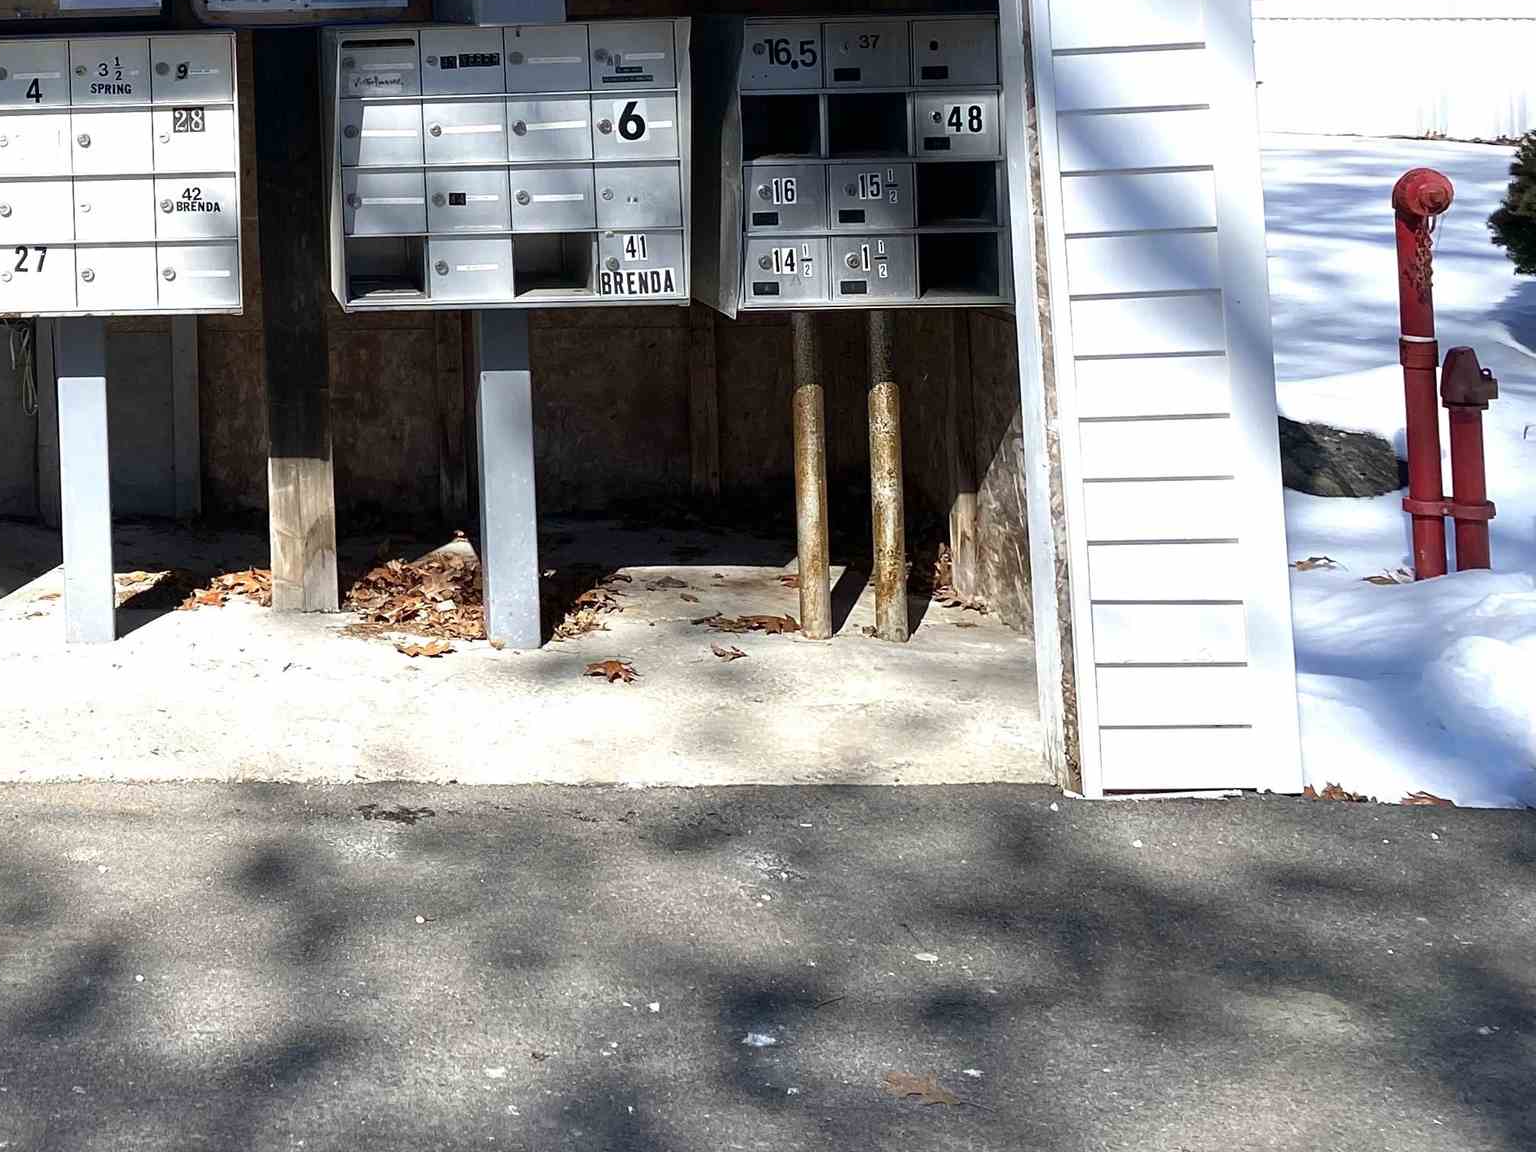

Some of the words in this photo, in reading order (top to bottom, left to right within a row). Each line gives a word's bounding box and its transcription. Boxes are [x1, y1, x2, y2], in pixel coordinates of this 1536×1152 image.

[765, 38, 817, 70] 16.5
[859, 35, 880, 49] 37
[176, 64, 188, 80] 9
[26, 78, 43, 104] 4
[90, 82, 132, 96] SPRING
[175, 109, 204, 132] 28
[617, 101, 646, 140] 6
[948, 105, 983, 133] 48
[181, 187, 202, 201] 42
[773, 179, 795, 203] 16
[176, 201, 221, 213] BRENDA
[14, 246, 47, 273] 27
[625, 235, 647, 260] 41
[600, 269, 675, 295] BRENDA
